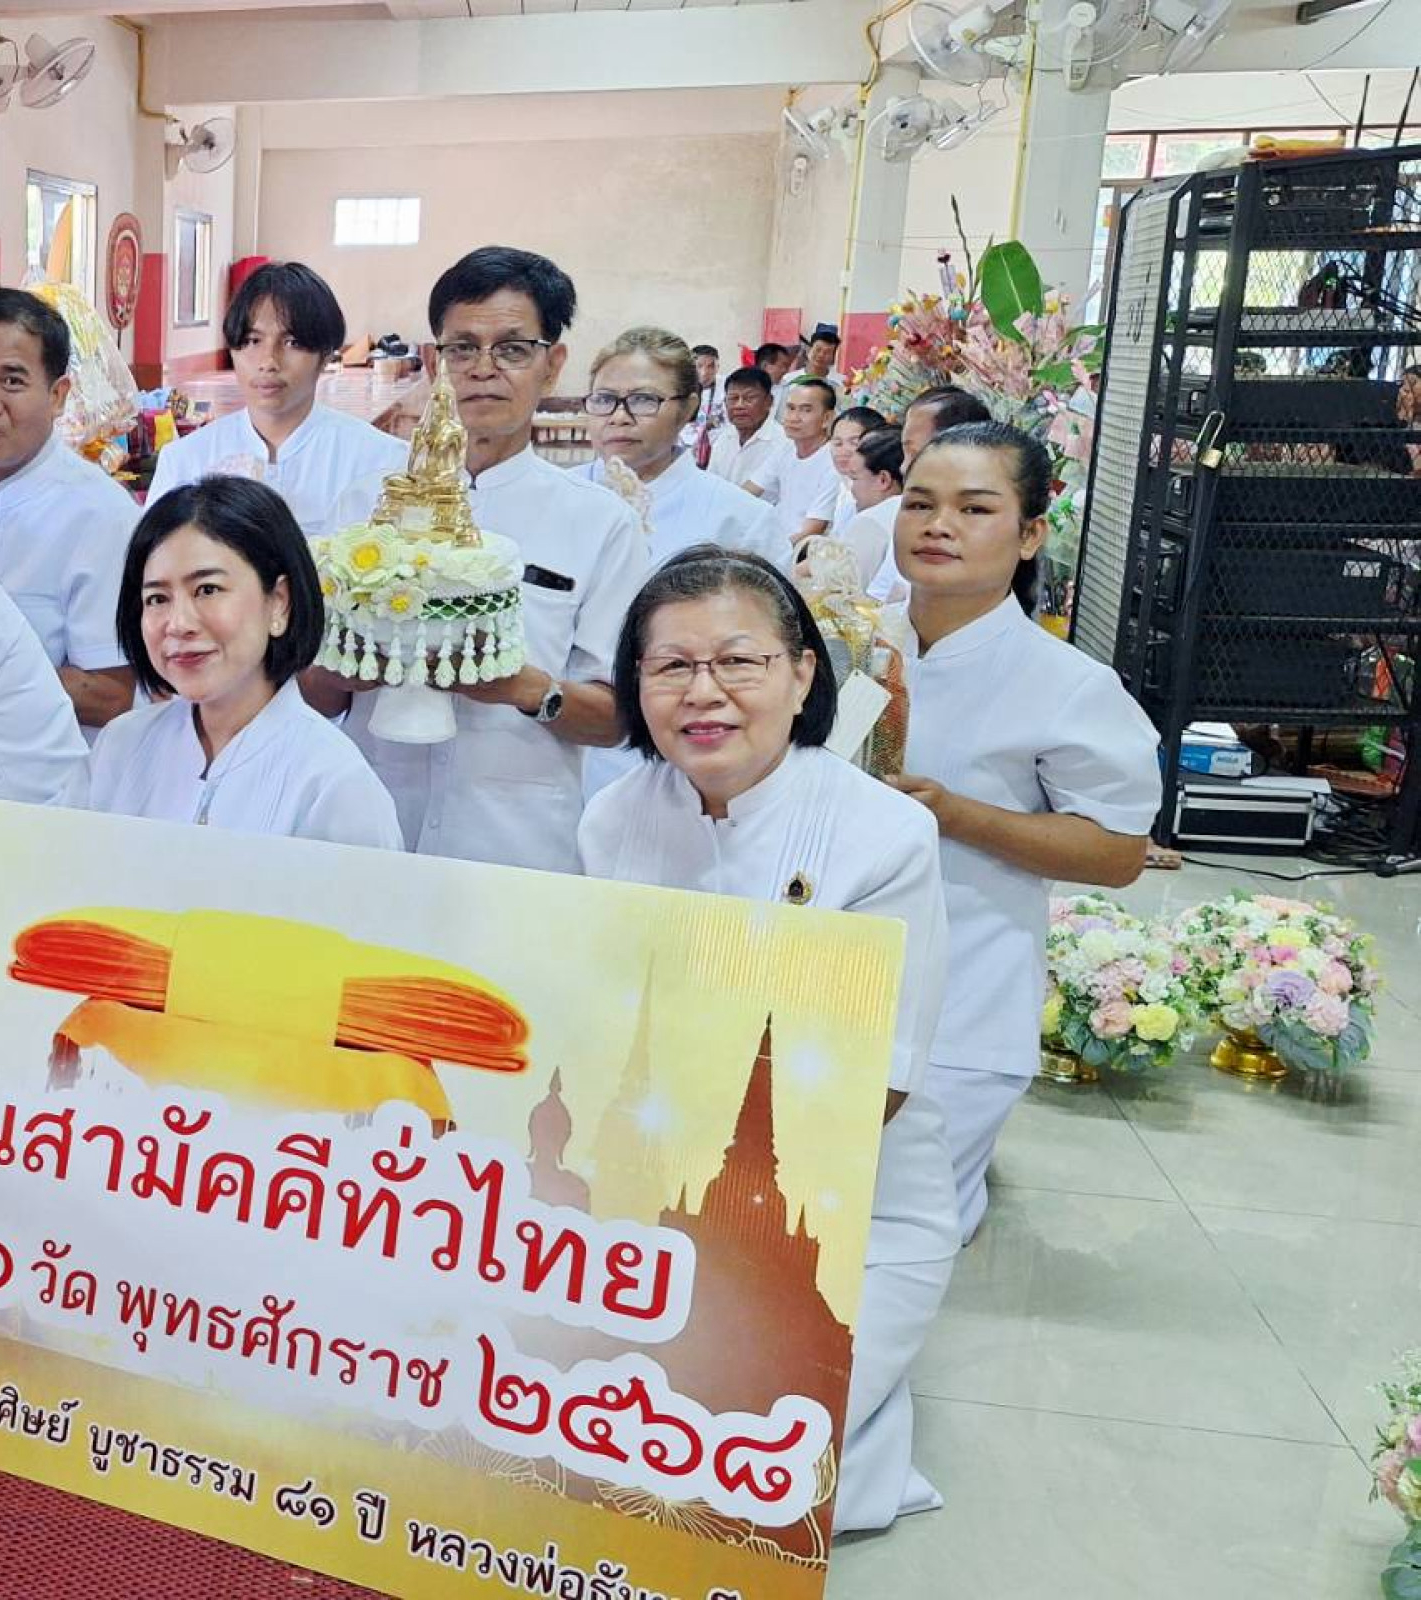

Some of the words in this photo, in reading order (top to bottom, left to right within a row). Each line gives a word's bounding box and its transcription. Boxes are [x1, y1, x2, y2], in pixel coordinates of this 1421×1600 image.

[31, 1240, 97, 1315] วัด
[118, 1280, 450, 1408] พุทธศักราช
[477, 1335, 807, 1502] ๒๕๖๘
[90, 1423, 256, 1502] บูชาธรรม
[276, 1478, 335, 1526] ๘๑
[356, 1493, 386, 1541] ปี
